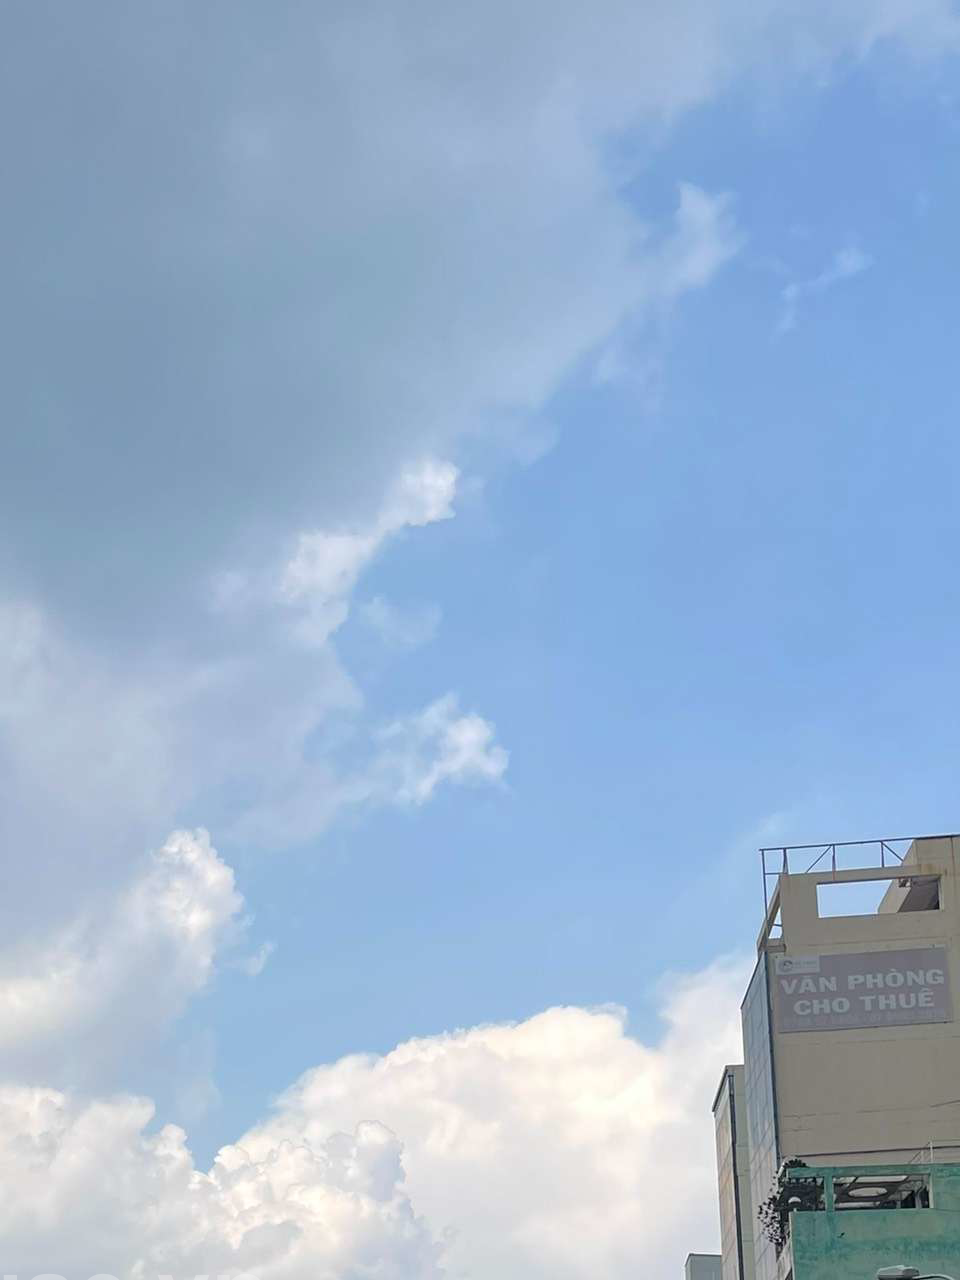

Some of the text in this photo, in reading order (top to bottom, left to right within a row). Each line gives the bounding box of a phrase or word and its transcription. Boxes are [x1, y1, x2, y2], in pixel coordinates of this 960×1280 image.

[780, 967, 944, 995] VĂN PHÒNG
[793, 990, 935, 1016] CHO THUÊ
